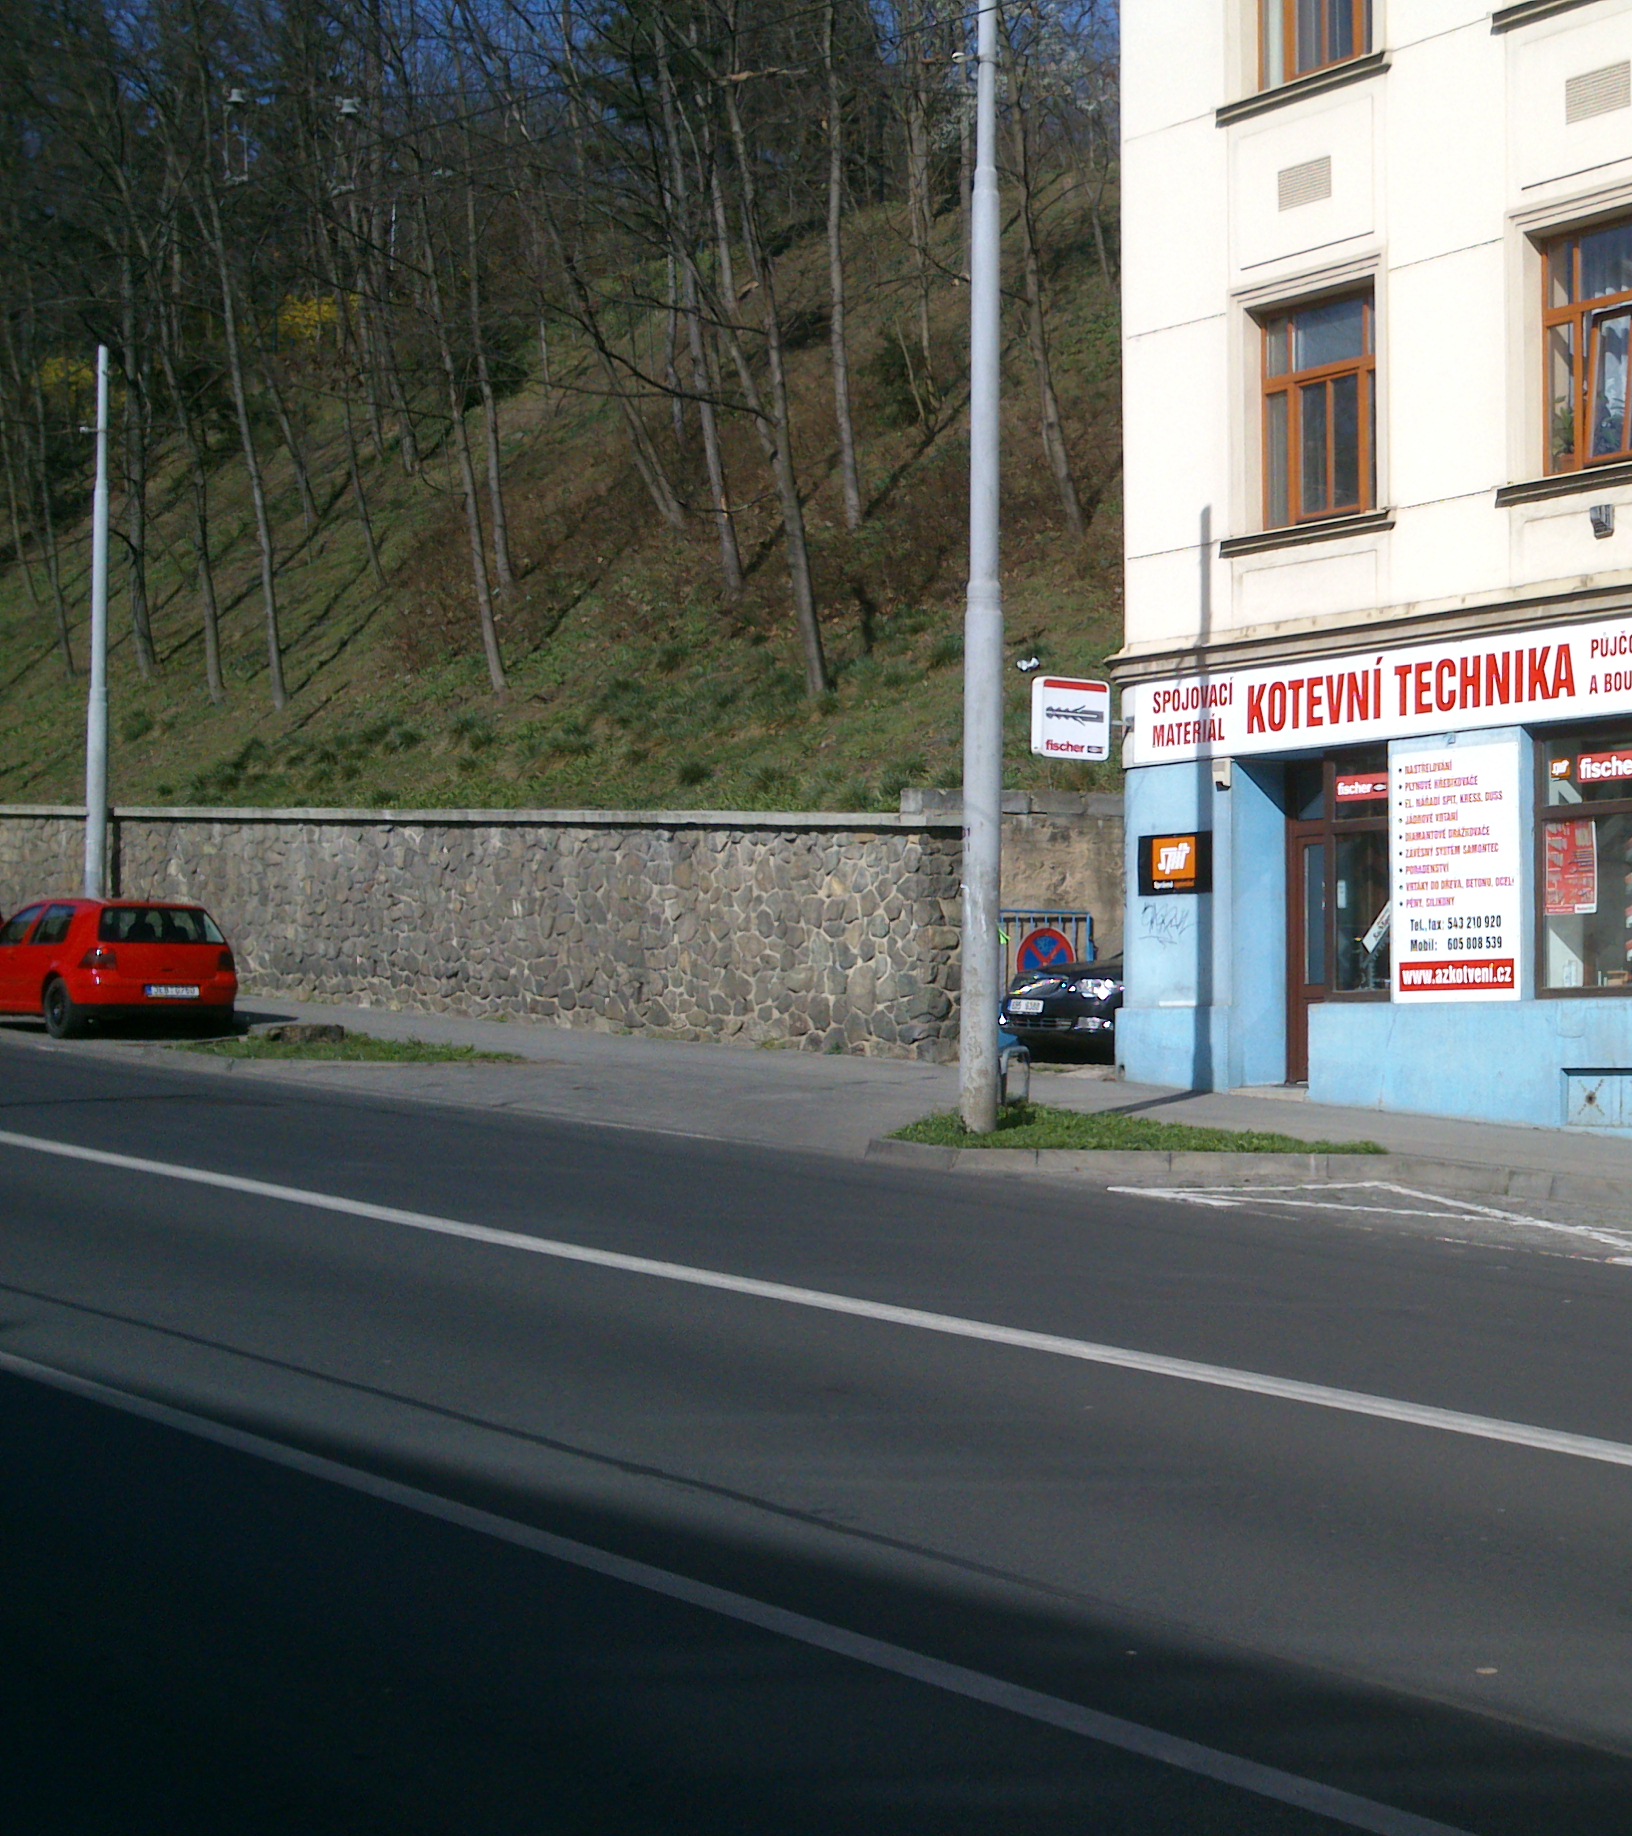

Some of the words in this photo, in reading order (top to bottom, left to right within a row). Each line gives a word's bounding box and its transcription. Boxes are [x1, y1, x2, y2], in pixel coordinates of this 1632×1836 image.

[1247, 656, 1383, 734] KOTEVNÍ
[1394, 643, 1576, 717] TECHNIKA
[1589, 675, 1598, 695] A
[1153, 677, 1233, 714] SPOJOVACÍ
[1152, 713, 1225, 748] MATERIÁL
[1045, 739, 1085, 753] fischer
[1337, 782, 1372, 796] fischer
[1447, 916, 1464, 930] 543
[1466, 915, 1482, 929] 210
[1485, 915, 1502, 928] 920
[1410, 938, 1438, 952] Mobil:
[1447, 937, 1464, 951] 605
[1466, 936, 1483, 950] 808
[1485, 935, 1502, 949] 539
